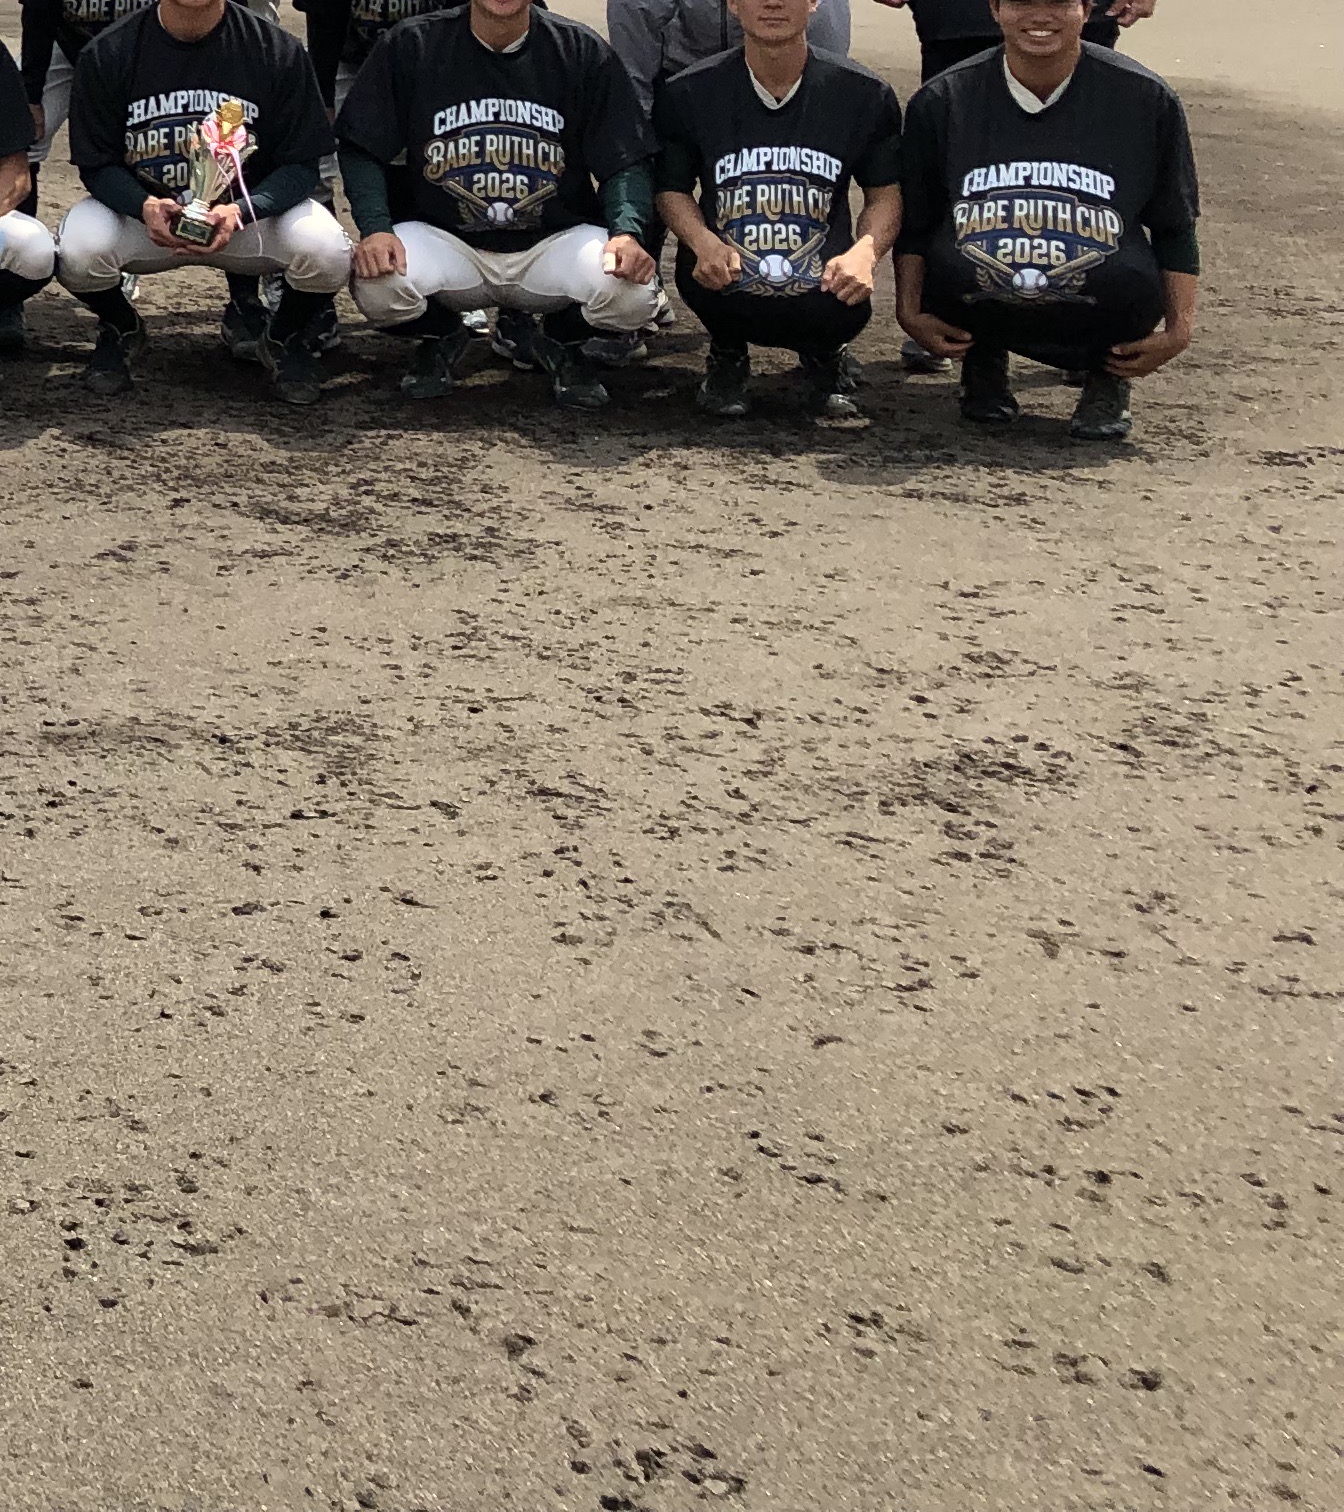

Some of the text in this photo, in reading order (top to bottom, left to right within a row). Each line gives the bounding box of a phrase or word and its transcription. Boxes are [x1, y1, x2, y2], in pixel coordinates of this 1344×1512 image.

[427, 138, 481, 181] BABE
[485, 134, 535, 170] RUTH
[472, 172, 529, 198] 2026
[961, 162, 1115, 200] CHAMPIONSHIP
[755, 184, 804, 221] RUTH
[743, 224, 802, 251] 2026
[955, 199, 1119, 248] BABE RUTH CUP
[997, 238, 1067, 266] 2026
